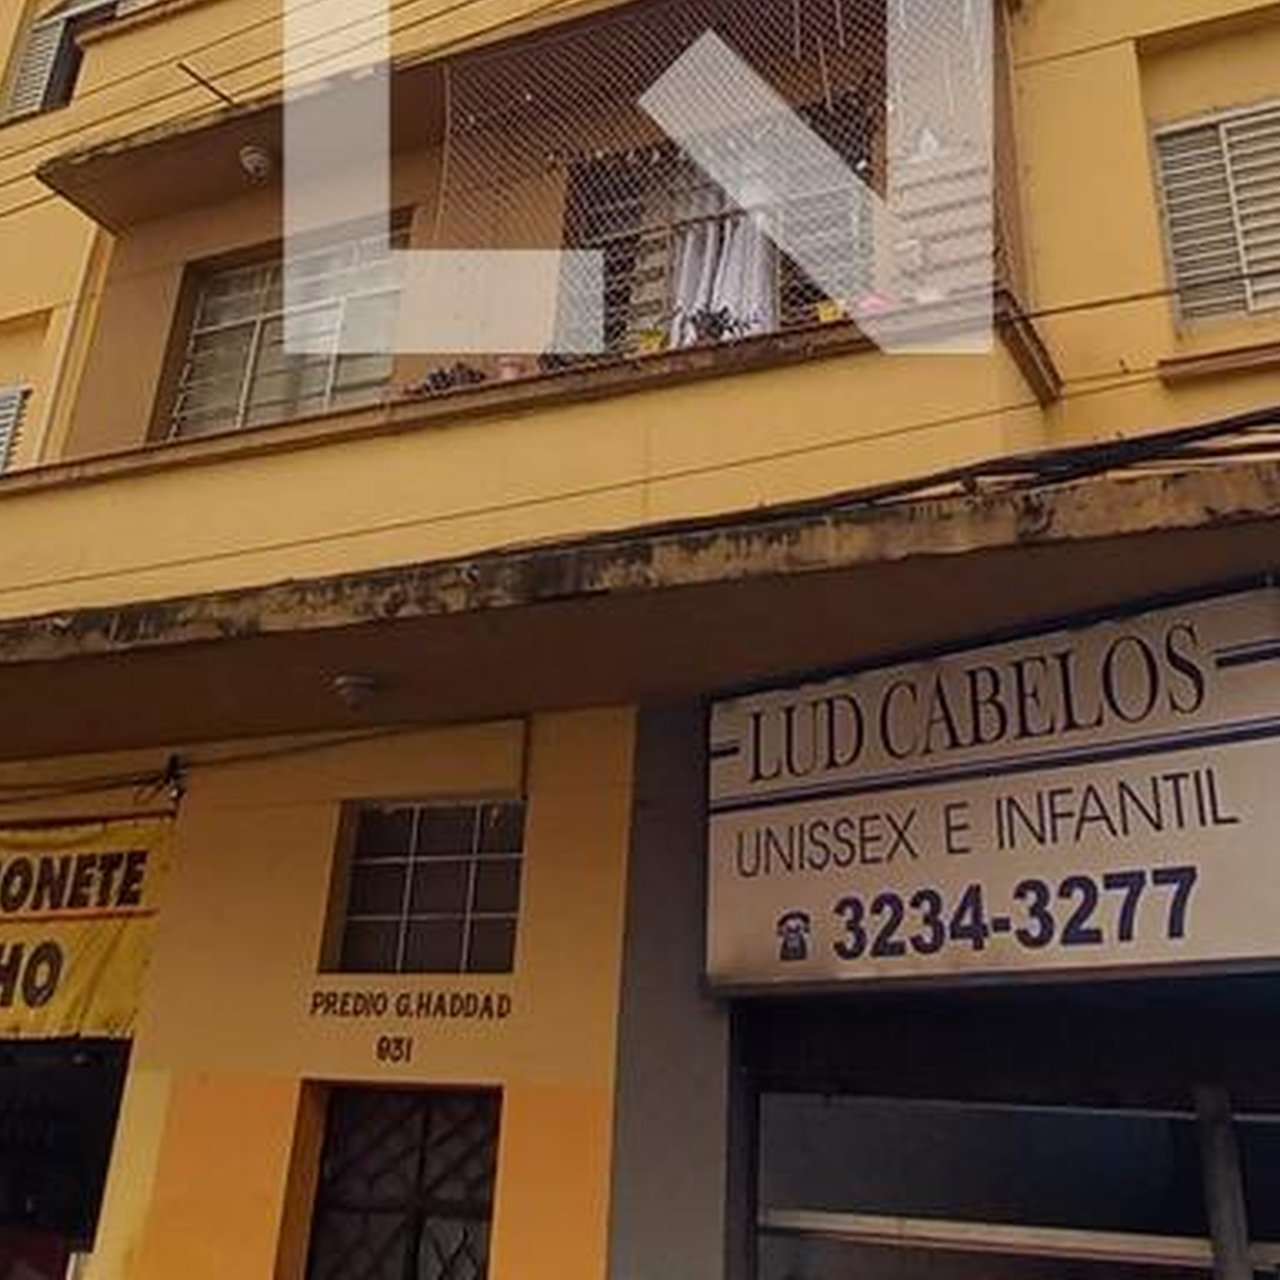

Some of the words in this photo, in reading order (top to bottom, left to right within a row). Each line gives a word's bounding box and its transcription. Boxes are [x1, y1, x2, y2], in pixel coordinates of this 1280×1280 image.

[748, 692, 866, 783] LUD
[878, 623, 1206, 760] CABELOS
[735, 808, 919, 878] UNISSEX
[945, 802, 972, 854] E
[996, 767, 1241, 851] INFANTIL
[832, 864, 1199, 961] 3234-3277
[310, 990, 389, 1017] PREDIO
[375, 1035, 414, 1064] 931
